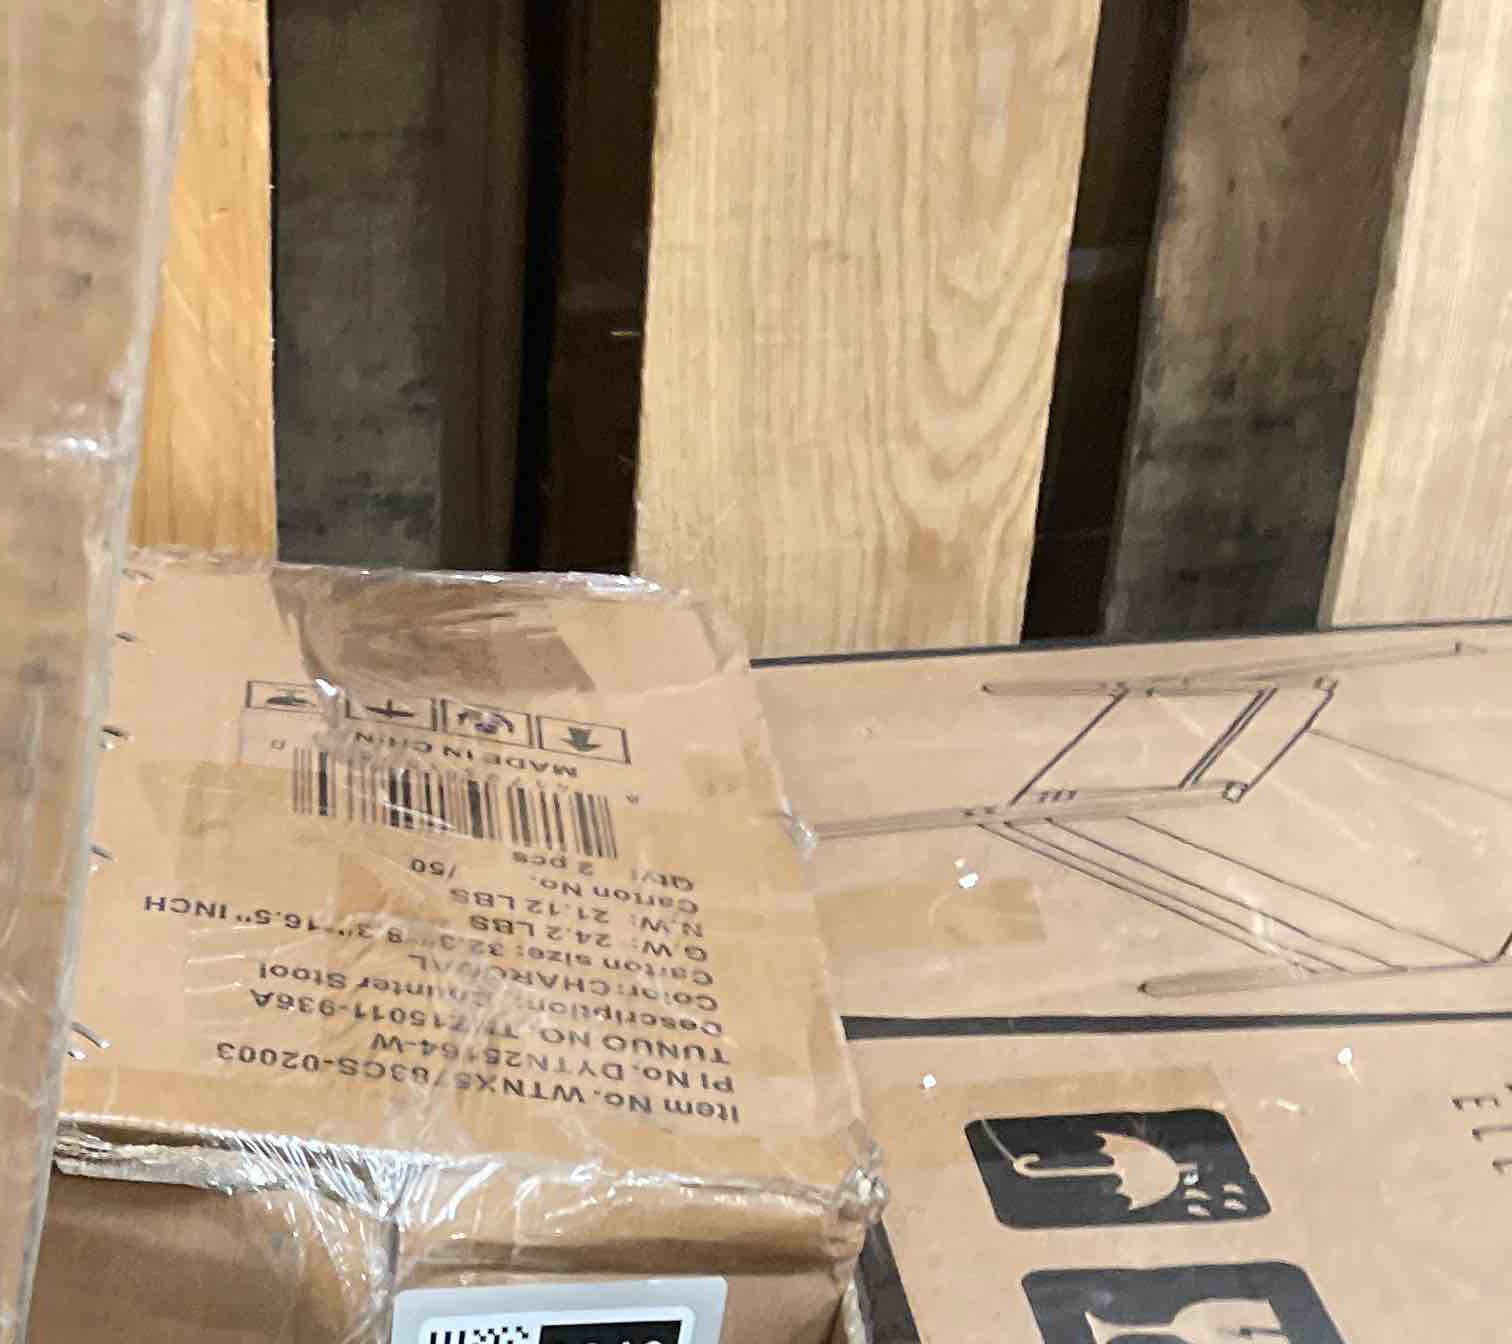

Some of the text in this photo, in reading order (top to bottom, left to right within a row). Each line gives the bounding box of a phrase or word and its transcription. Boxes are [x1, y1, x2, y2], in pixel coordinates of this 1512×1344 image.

[338, 730, 433, 753] CHIN
[442, 746, 474, 760] IN
[478, 752, 579, 779] MADE
[512, 851, 568, 871] pcs
[576, 861, 594, 876] 2
[143, 895, 228, 920] INCH
[448, 888, 516, 910] LBS
[592, 886, 699, 914] Carton
[524, 899, 611, 924] 21.12
[467, 915, 536, 938] LBS
[544, 925, 612, 948] 24.2
[516, 945, 592, 968] size:
[258, 963, 347, 991] Stool
[602, 957, 714, 986] Carton
[601, 1035, 730, 1065] TUNUO
[632, 1065, 689, 1089] No.
[700, 1072, 735, 1094] PI
[593, 1090, 652, 1114] No.
[663, 1099, 740, 1124] Item
